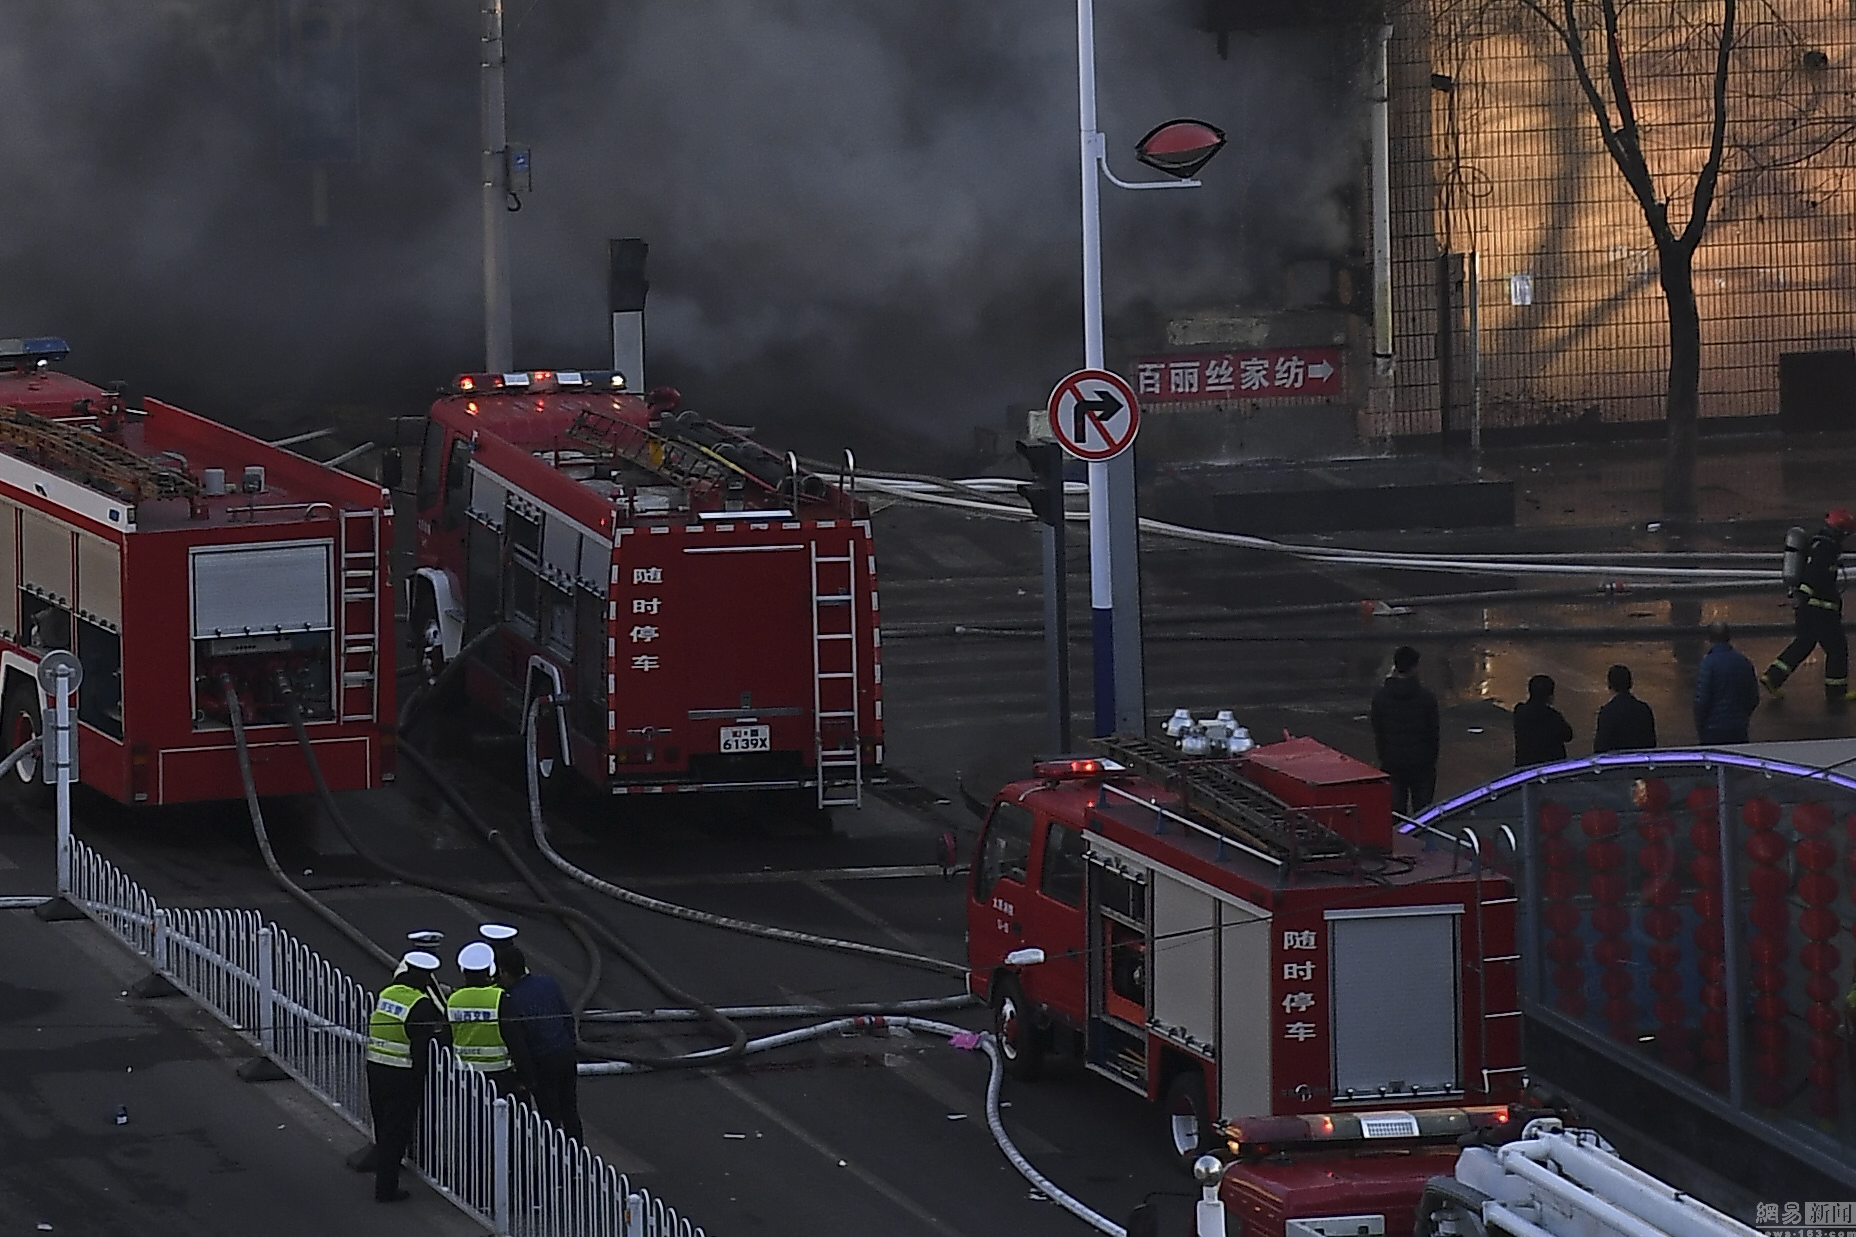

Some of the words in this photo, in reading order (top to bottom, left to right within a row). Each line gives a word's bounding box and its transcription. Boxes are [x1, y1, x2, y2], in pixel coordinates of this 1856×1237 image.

[1138, 356, 1305, 394] 百丽丝家纺
[630, 567, 663, 671] 随时停车
[723, 738, 767, 750] 6139X
[1282, 930, 1318, 1041] 随时停车
